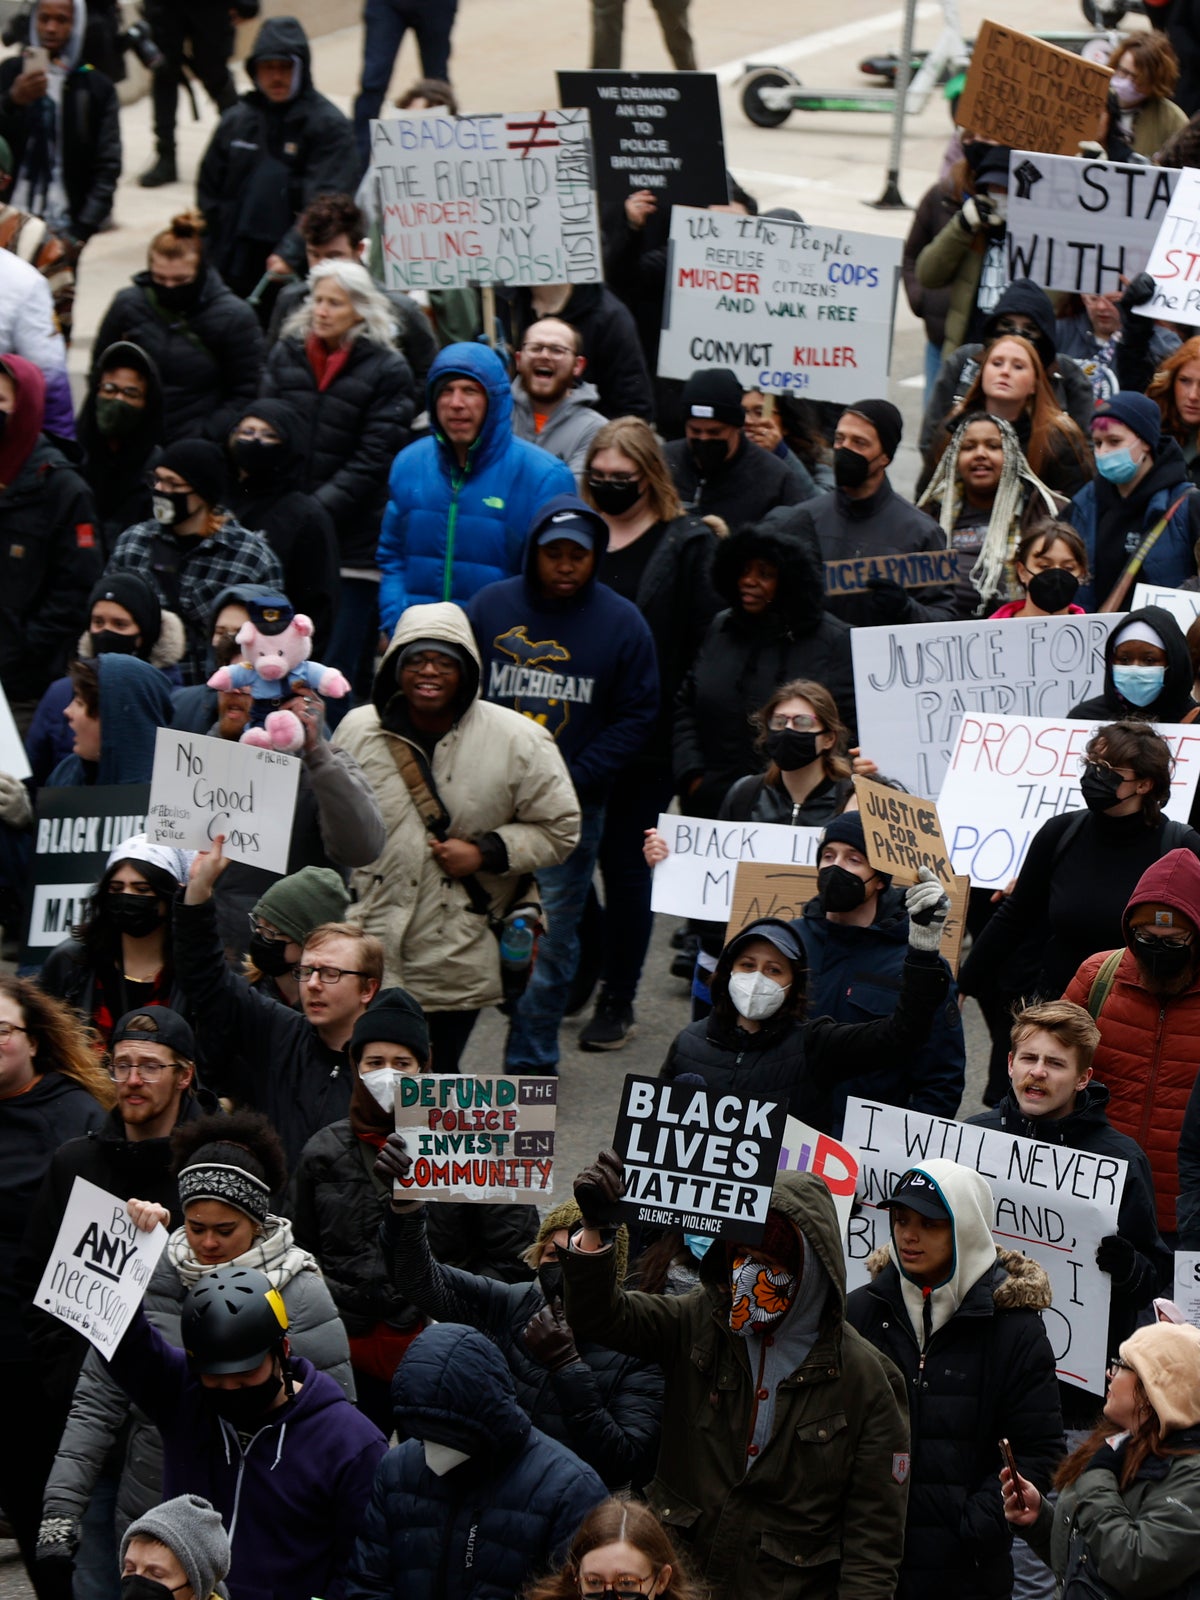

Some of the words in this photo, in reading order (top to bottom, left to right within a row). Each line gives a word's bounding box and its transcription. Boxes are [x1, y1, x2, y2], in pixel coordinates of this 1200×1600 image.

[1011, 35, 1042, 67] YOU
[597, 86, 620, 99] WE
[621, 87, 681, 100] DEMAND
[615, 104, 635, 117] AN
[637, 105, 667, 118] END
[374, 122, 393, 147] A
[399, 119, 499, 150] BADGE
[632, 122, 654, 134] TO
[619, 139, 670, 152] POLICE
[376, 165, 425, 199] THE
[433, 159, 507, 201] RIGHT
[515, 157, 549, 196] TO
[610, 156, 682, 170] BRUTALITY
[629, 174, 668, 187] NOW!
[479, 197, 540, 225] STOP
[382, 230, 484, 262] KILLING
[496, 224, 535, 257] MY
[789, 224, 854, 263] People
[705, 247, 765, 269] REFUSE
[776, 258, 791, 275] TO
[797, 260, 816, 278] SEE
[828, 262, 879, 288] COPS
[1006, 231, 1125, 294] WITH
[677, 268, 761, 295] MURDER
[772, 279, 838, 298] CITIZENS
[715, 295, 755, 314] AND
[765, 300, 807, 319] WALK
[818, 305, 859, 322] FREE
[690, 336, 774, 367] CONVICT
[793, 346, 858, 368] KILLER
[758, 370, 809, 388] COPS!
[868, 629, 1007, 692] JUSTICE
[1026, 620, 1109, 678] FOR
[488, 660, 595, 704] MICHIGAN
[176, 742, 203, 777] No
[193, 778, 254, 814] Good
[157, 818, 176, 830] the
[866, 791, 940, 838] JUSTICE
[36, 816, 102, 854] BLACK
[102, 815, 148, 852] LIVE
[155, 828, 186, 842] police
[207, 812, 260, 854] Cops
[674, 824, 759, 860] BLACK
[888, 823, 918, 848] FOR
[872, 831, 951, 883] PATRICK
[400, 1076, 516, 1108] DEFUND
[521, 1084, 552, 1098] THE
[428, 1108, 517, 1131] POLICE
[626, 1081, 778, 1139] BLACK
[418, 1133, 510, 1156] INVEST
[520, 1136, 549, 1152] IN
[626, 1123, 761, 1179] LIVES
[859, 1104, 883, 1152] I
[905, 1113, 997, 1179] WILL
[1007, 1140, 1119, 1205] NEVER
[621, 1168, 759, 1217] MATTER
[638, 1208, 674, 1225] SILENCE
[682, 1214, 722, 1233] VIOLENCE
[73, 1222, 138, 1276] ANY
[465, 1524, 479, 1569] NAUTICA
